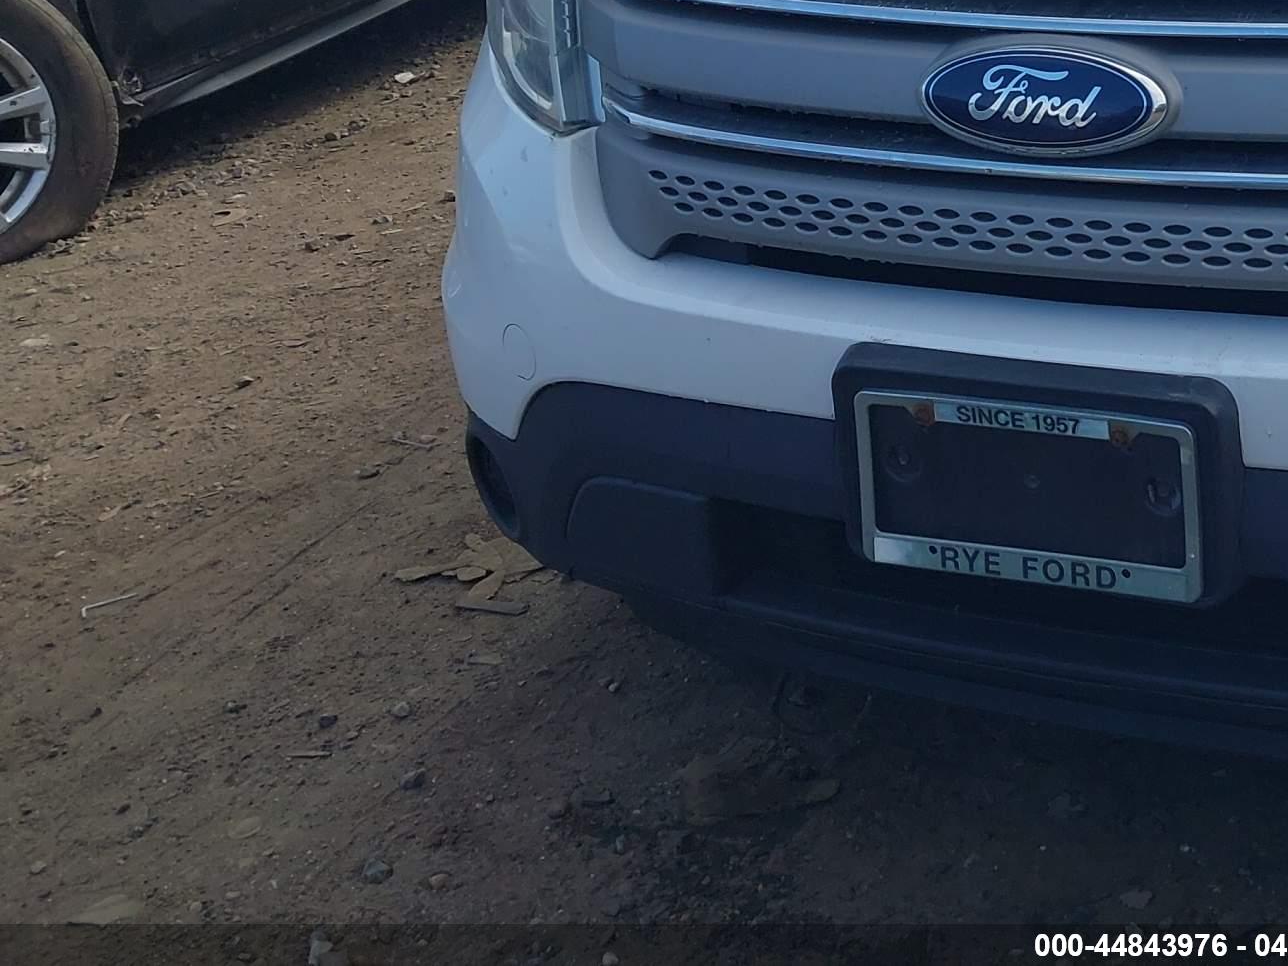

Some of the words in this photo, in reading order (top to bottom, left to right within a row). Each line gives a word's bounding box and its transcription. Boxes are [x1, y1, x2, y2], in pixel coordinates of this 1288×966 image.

[968, 64, 1101, 128] Ford
[957, 406, 1025, 429] SINCE
[1031, 414, 1080, 434] 1957
[940, 545, 1001, 576] RYE
[1022, 556, 1117, 589] FORD
